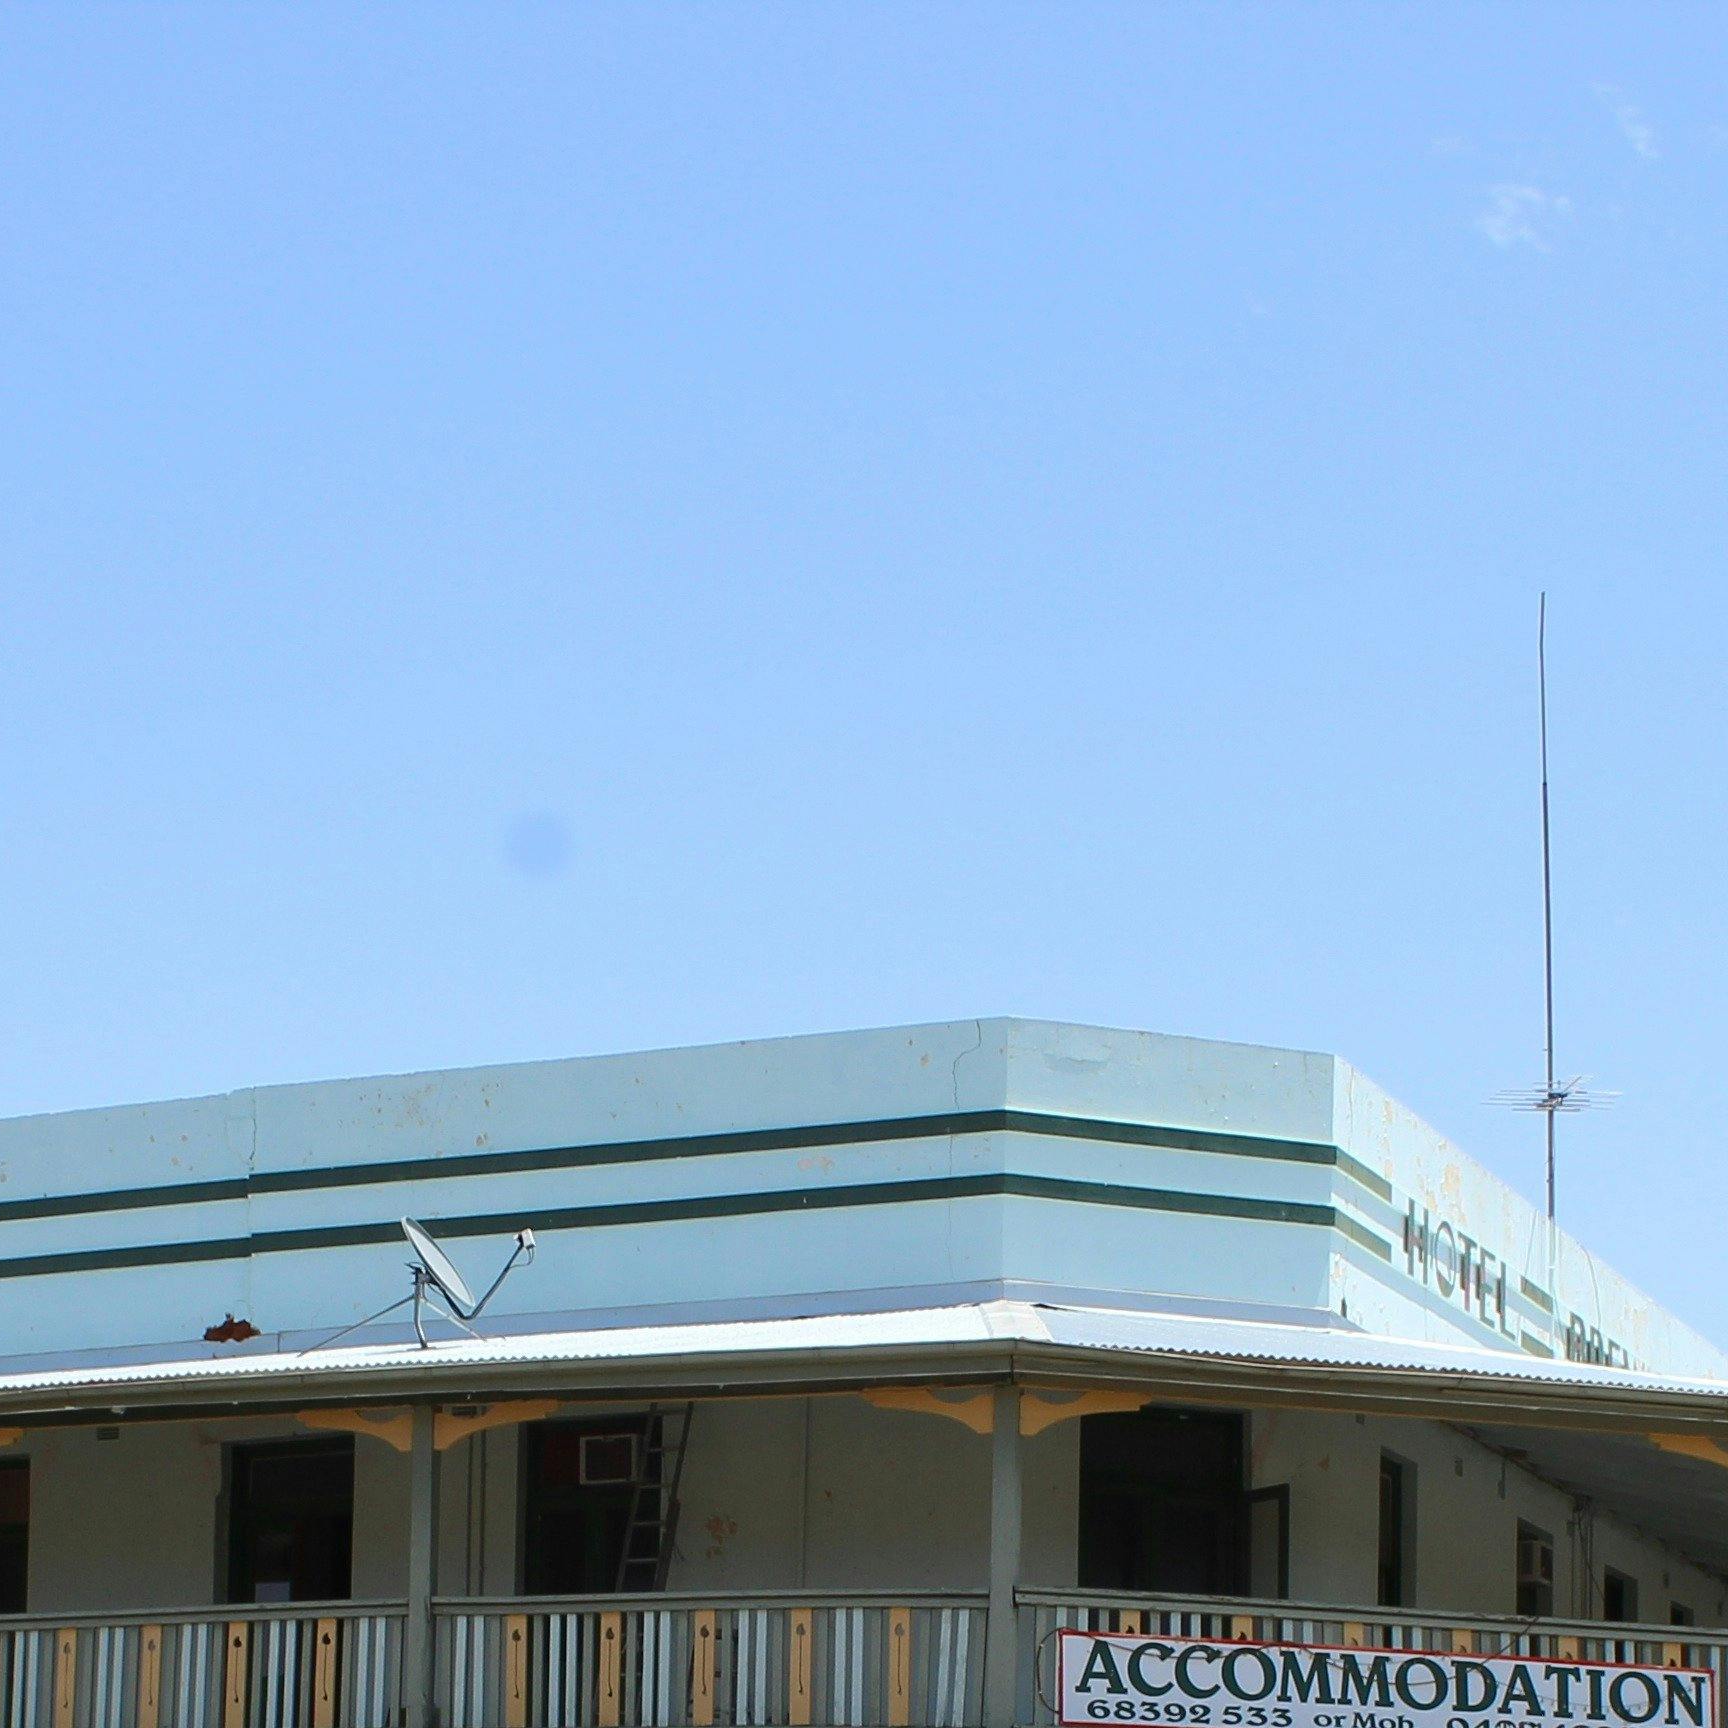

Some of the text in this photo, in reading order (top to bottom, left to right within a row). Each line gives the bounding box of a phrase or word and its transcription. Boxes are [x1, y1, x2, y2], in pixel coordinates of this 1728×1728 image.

[1402, 1197, 1516, 1343] HOTEL
[1074, 1639, 1707, 1727] ACCOMMODATION
[1086, 1699, 1211, 1725] 68392
[1221, 1705, 1293, 1727] 533
[1313, 1713, 1347, 1728] or
